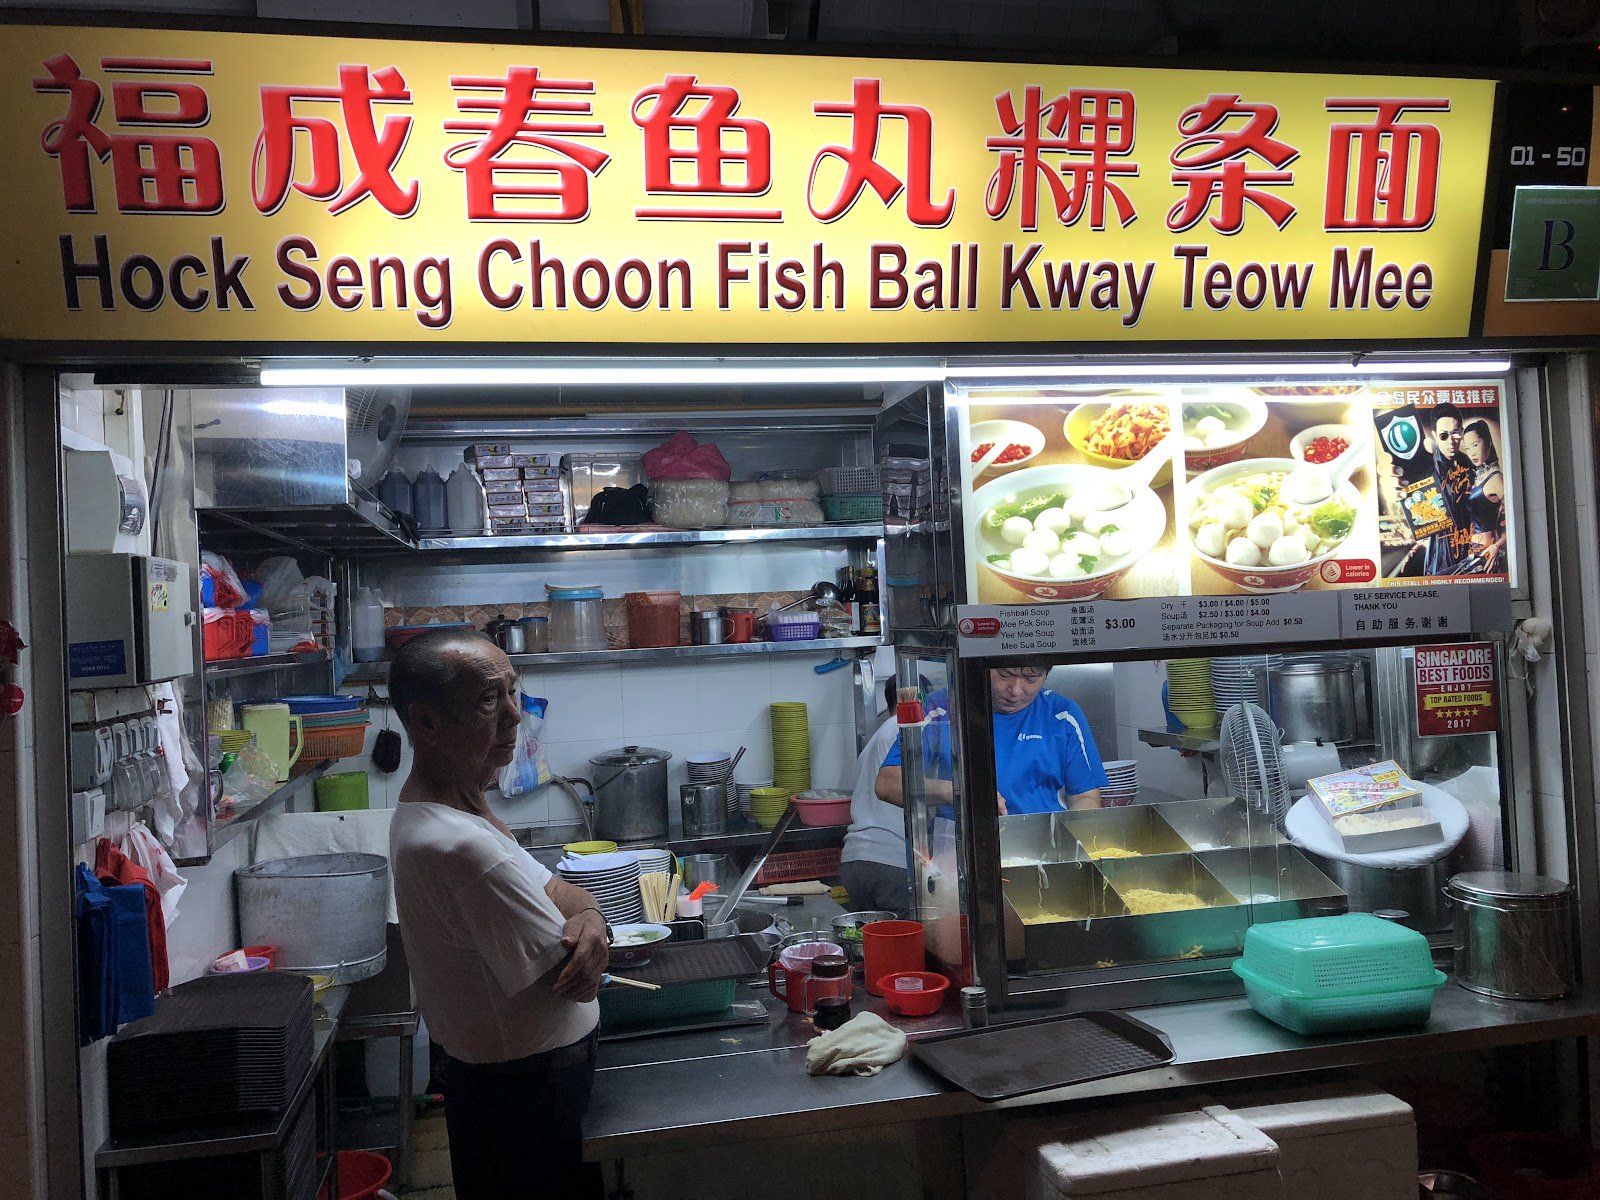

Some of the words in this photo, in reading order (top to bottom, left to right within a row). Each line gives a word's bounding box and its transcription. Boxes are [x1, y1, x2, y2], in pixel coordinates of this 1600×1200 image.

[33, 53, 1451, 233] 福成春鱼丸粿条面
[1536, 219, 1575, 271] B
[59, 235, 257, 312] Hock
[276, 236, 453, 330] Seng
[478, 239, 693, 312] Choon
[717, 241, 845, 312] Fish
[869, 243, 979, 312] Ball
[1002, 244, 1155, 328] Kway
[1174, 246, 1313, 312] Teow
[1329, 247, 1434, 312] Mee
[1353, 592, 1373, 601] SELF
[1374, 591, 1407, 600] SERVICE
[1408, 590, 1440, 599] PLEASE,
[1161, 602, 1174, 610] Dry
[1199, 600, 1219, 608] $3.00
[1225, 599, 1245, 607] $4.00
[1250, 598, 1270, 606] $5.00
[1354, 603, 1380, 611] THANK
[1381, 602, 1398, 610] YOU
[999, 609, 1029, 617] Fishball
[1030, 608, 1050, 617] Soup
[1250, 609, 1270, 617] $4.00
[1000, 620, 1017, 628] Mee
[1018, 619, 1033, 627] Pok
[1035, 619, 1055, 628] Soup
[1105, 617, 1136, 631] $3.00
[1162, 622, 1195, 631] Separate
[1196, 620, 1233, 630] Packaging
[1234, 619, 1244, 627] for
[1245, 618, 1264, 627] Soup
[1266, 618, 1280, 626] Add
[1283, 617, 1303, 626] $0.50
[1001, 631, 1015, 639] Yee
[1017, 630, 1034, 638] Mee
[1036, 630, 1055, 639] Soup
[1219, 630, 1239, 639] $0.50
[1001, 642, 1018, 650] Mee
[1020, 641, 1035, 649] Sua
[1036, 640, 1057, 649] Soup
[1417, 648, 1493, 668] SINGAPORE
[1419, 668, 1449, 683] BEST
[1452, 665, 1491, 681] FOODS
[1440, 684, 1472, 693] ENJOY
[1430, 696, 1442, 704] TOP
[1443, 695, 1463, 703] RATED
[1463, 693, 1483, 702] FOODS
[1447, 719, 1471, 729] 2017
